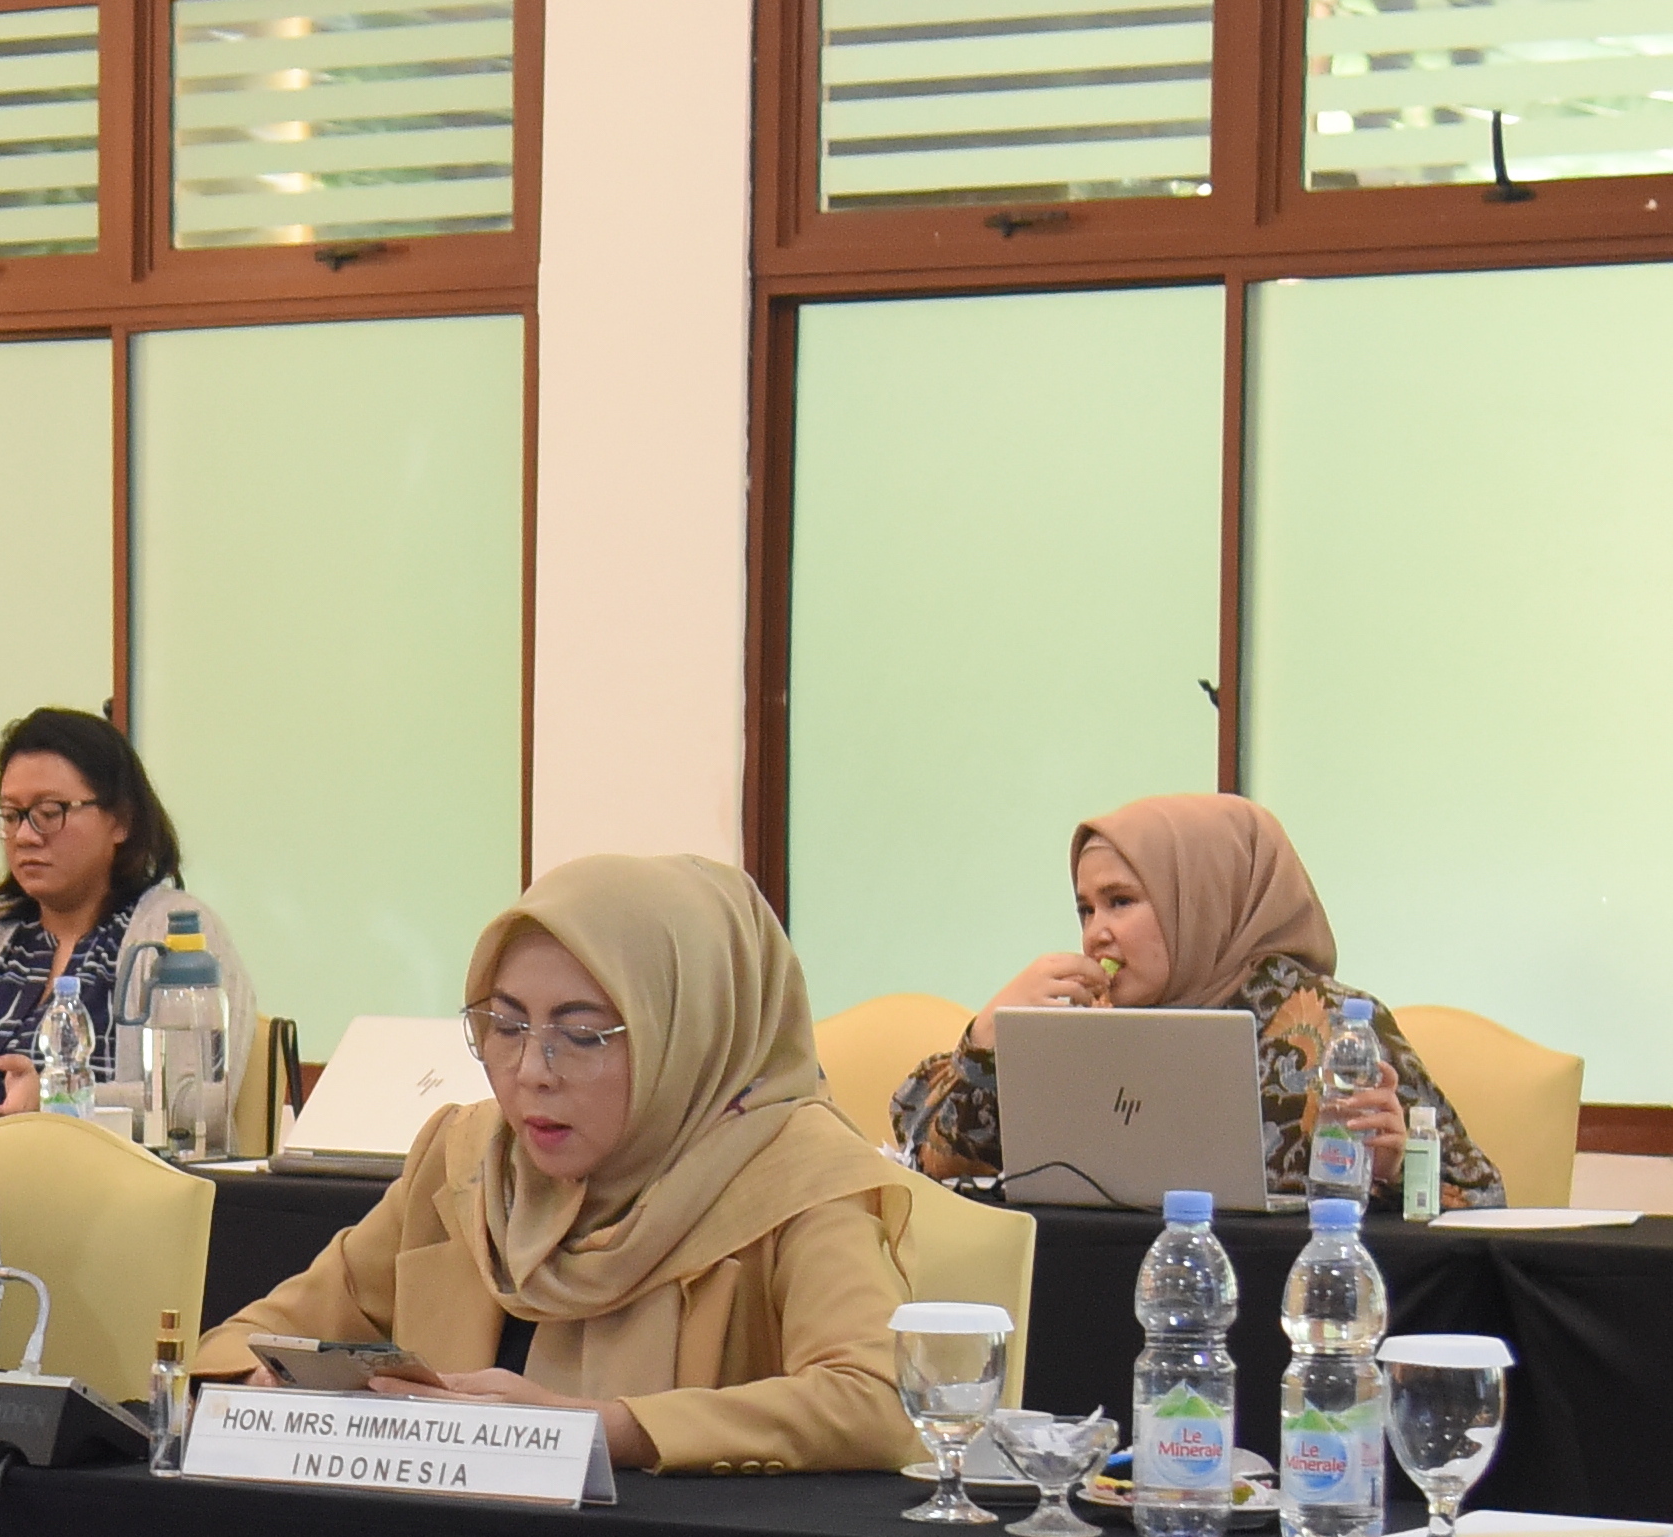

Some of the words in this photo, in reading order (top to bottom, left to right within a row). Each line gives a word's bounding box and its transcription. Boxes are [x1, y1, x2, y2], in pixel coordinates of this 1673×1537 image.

[1113, 1086, 1142, 1126] hp
[222, 1407, 277, 1433] HON.
[283, 1412, 338, 1437] MRS.
[346, 1416, 466, 1445] HIMMATUL
[471, 1423, 561, 1451] ALIYAH
[1182, 1427, 1203, 1444] Le
[1158, 1440, 1223, 1458] Minerale
[1300, 1440, 1320, 1457] Le
[291, 1452, 468, 1487] INDONESIA
[1285, 1454, 1347, 1473] Minerale
